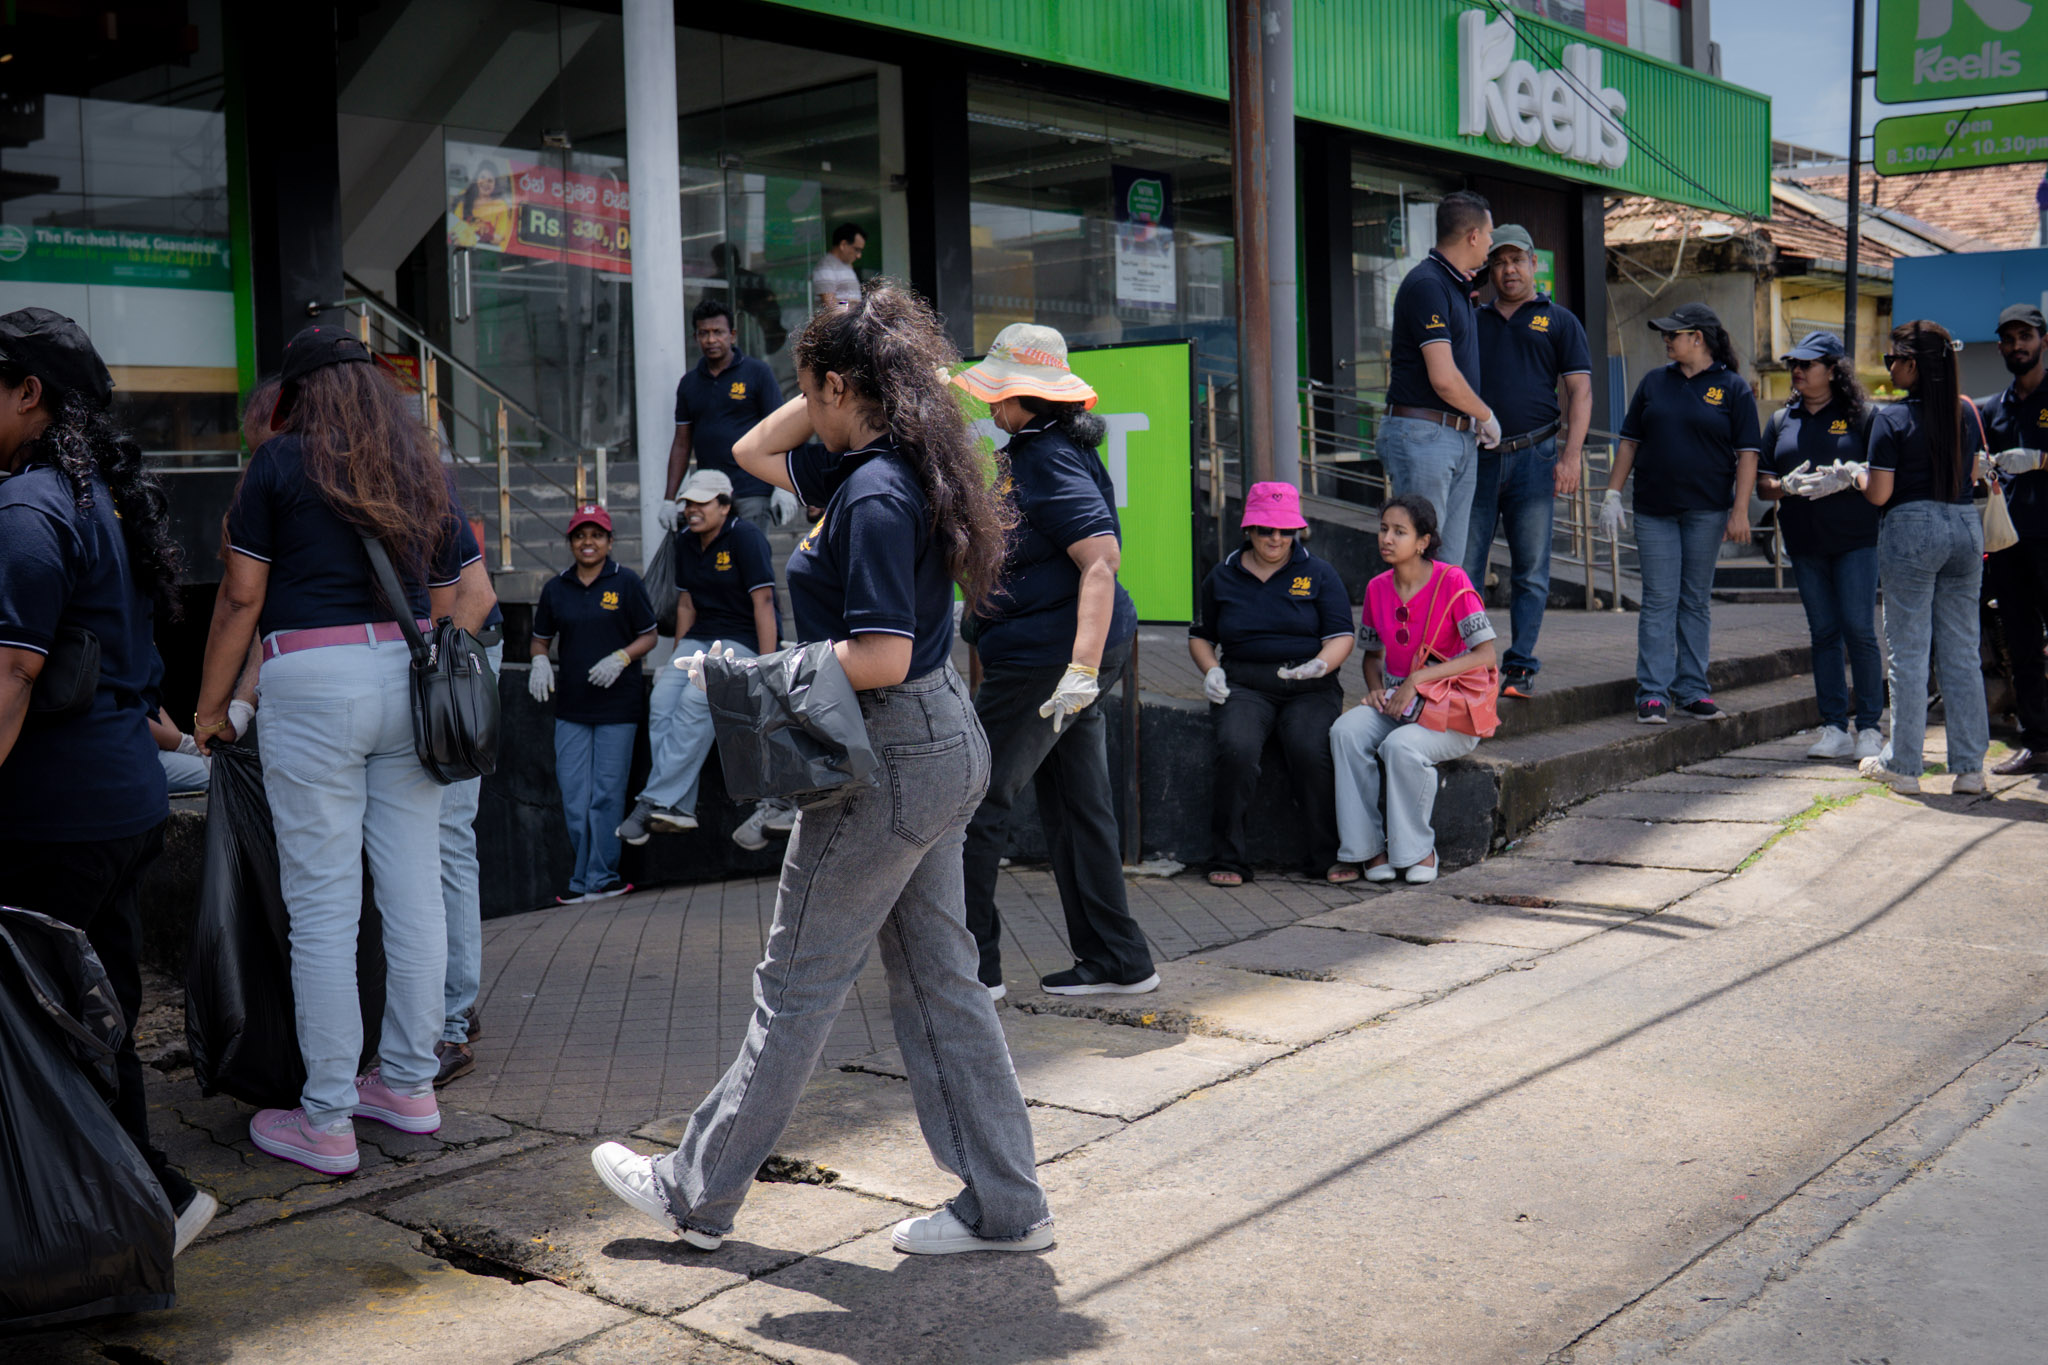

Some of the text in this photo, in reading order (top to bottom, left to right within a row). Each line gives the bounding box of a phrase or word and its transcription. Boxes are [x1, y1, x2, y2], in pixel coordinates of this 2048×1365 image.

[1913, 40, 2021, 85] Keells
[1458, 9, 1628, 169] Keells
[1945, 120, 1993, 138] Open
[1886, 145, 1954, 164] 8.30am
[530, 210, 566, 238] Rs.
[35, 230, 61, 243] The
